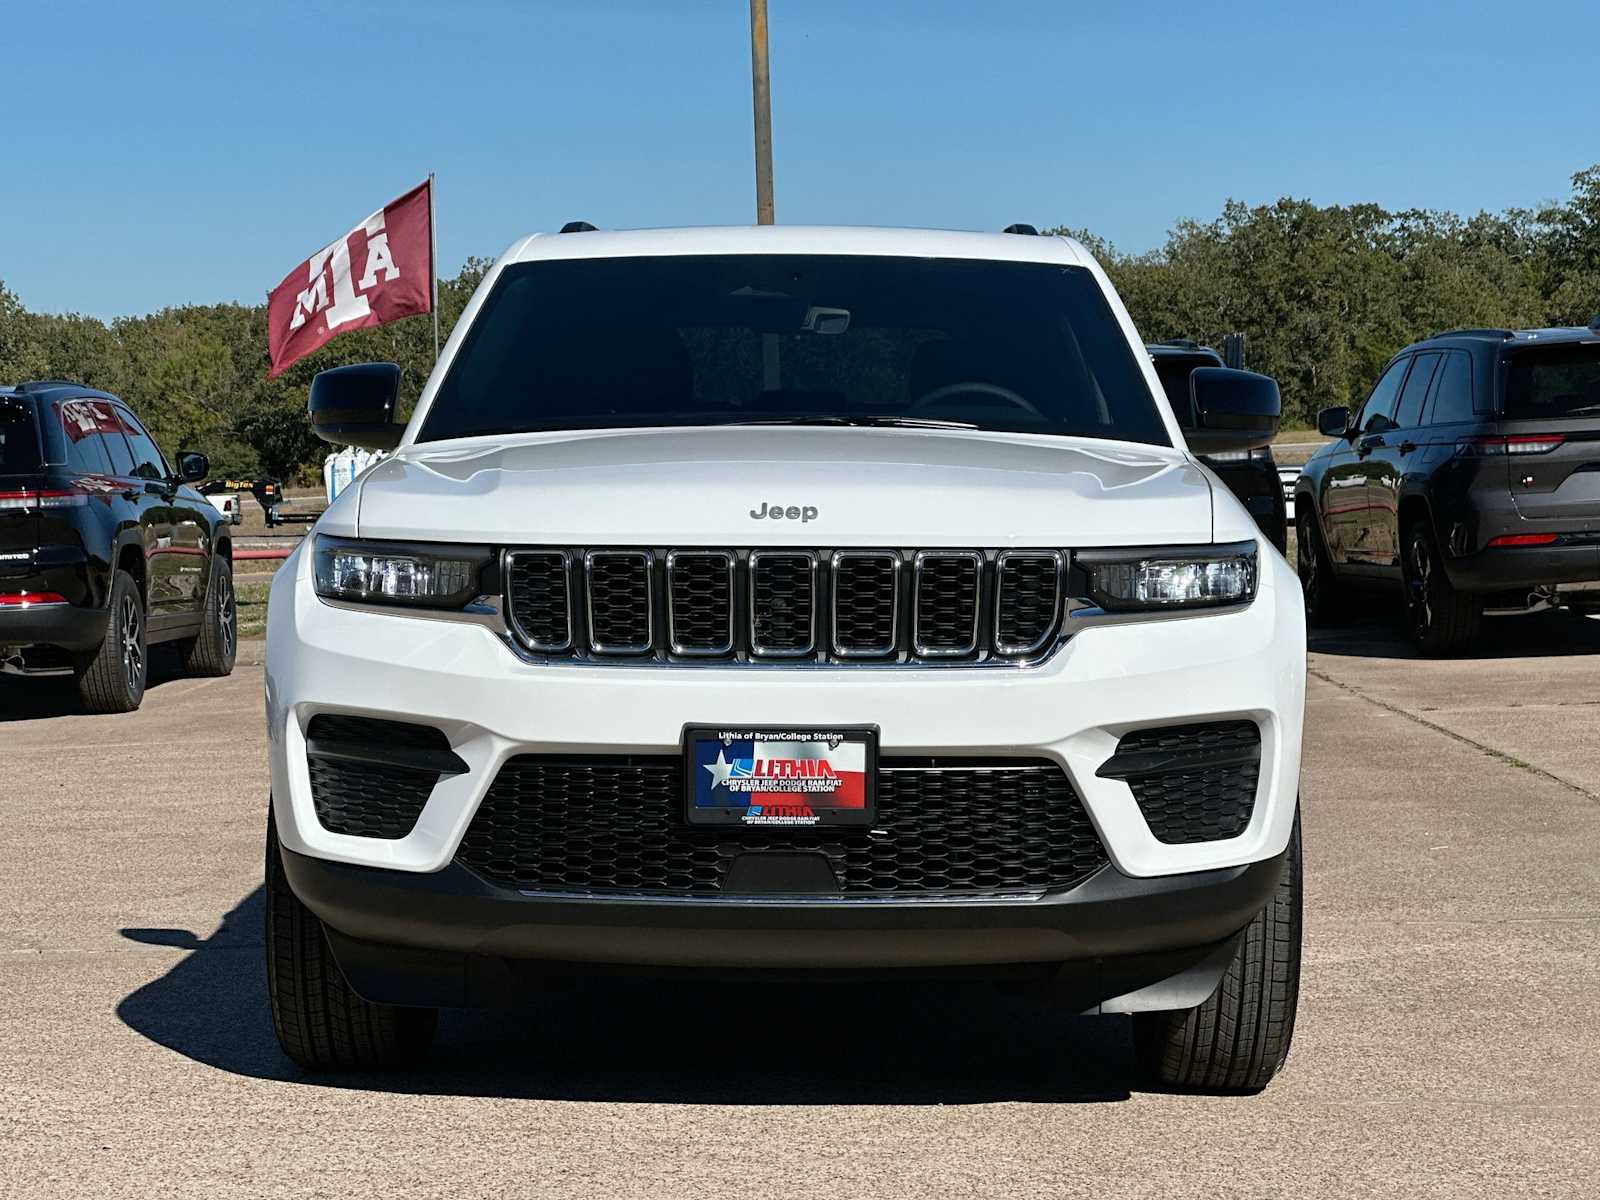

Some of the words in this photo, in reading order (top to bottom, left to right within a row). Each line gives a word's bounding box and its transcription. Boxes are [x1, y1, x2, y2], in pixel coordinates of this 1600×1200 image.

[749, 502, 818, 523] Jeep
[718, 732, 742, 740] Lithia
[743, 732, 754, 740] of
[755, 732, 812, 742] Bryan/College
[813, 732, 844, 740] Station
[753, 759, 837, 778] LITHIA
